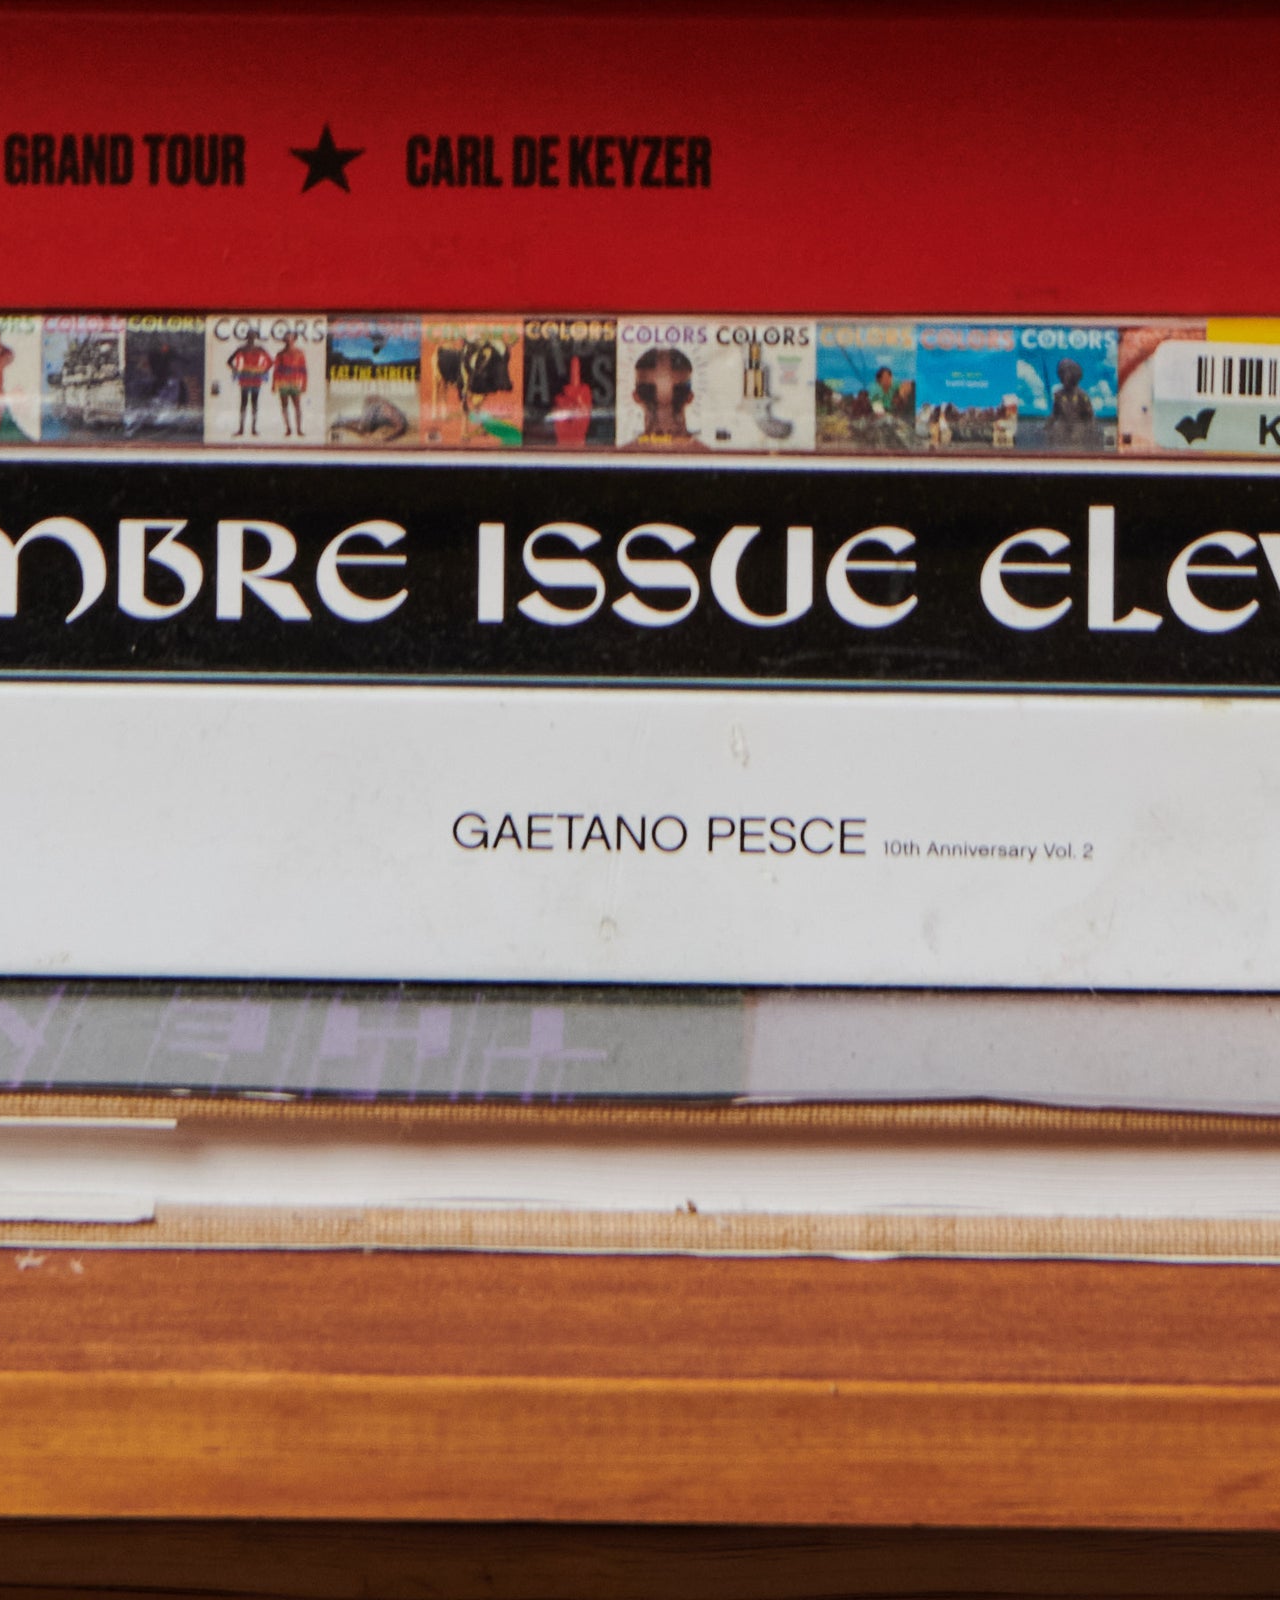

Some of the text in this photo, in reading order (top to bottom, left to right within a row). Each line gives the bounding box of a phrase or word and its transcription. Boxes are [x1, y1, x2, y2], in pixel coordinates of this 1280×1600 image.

[3, 132, 134, 187] GRAND
[141, 132, 246, 188] TOUR
[405, 133, 713, 189] CARL DE KEYZER
[214, 318, 325, 343] COLORS
[621, 325, 708, 346] COLORS
[716, 326, 810, 347] COLORS
[921, 328, 1016, 351] COLORS
[1022, 329, 1115, 350] COLORS
[476, 521, 919, 629] ISSUE
[451, 812, 1095, 863] GAETANO PESCE 10th Anniversary Vol. 2
